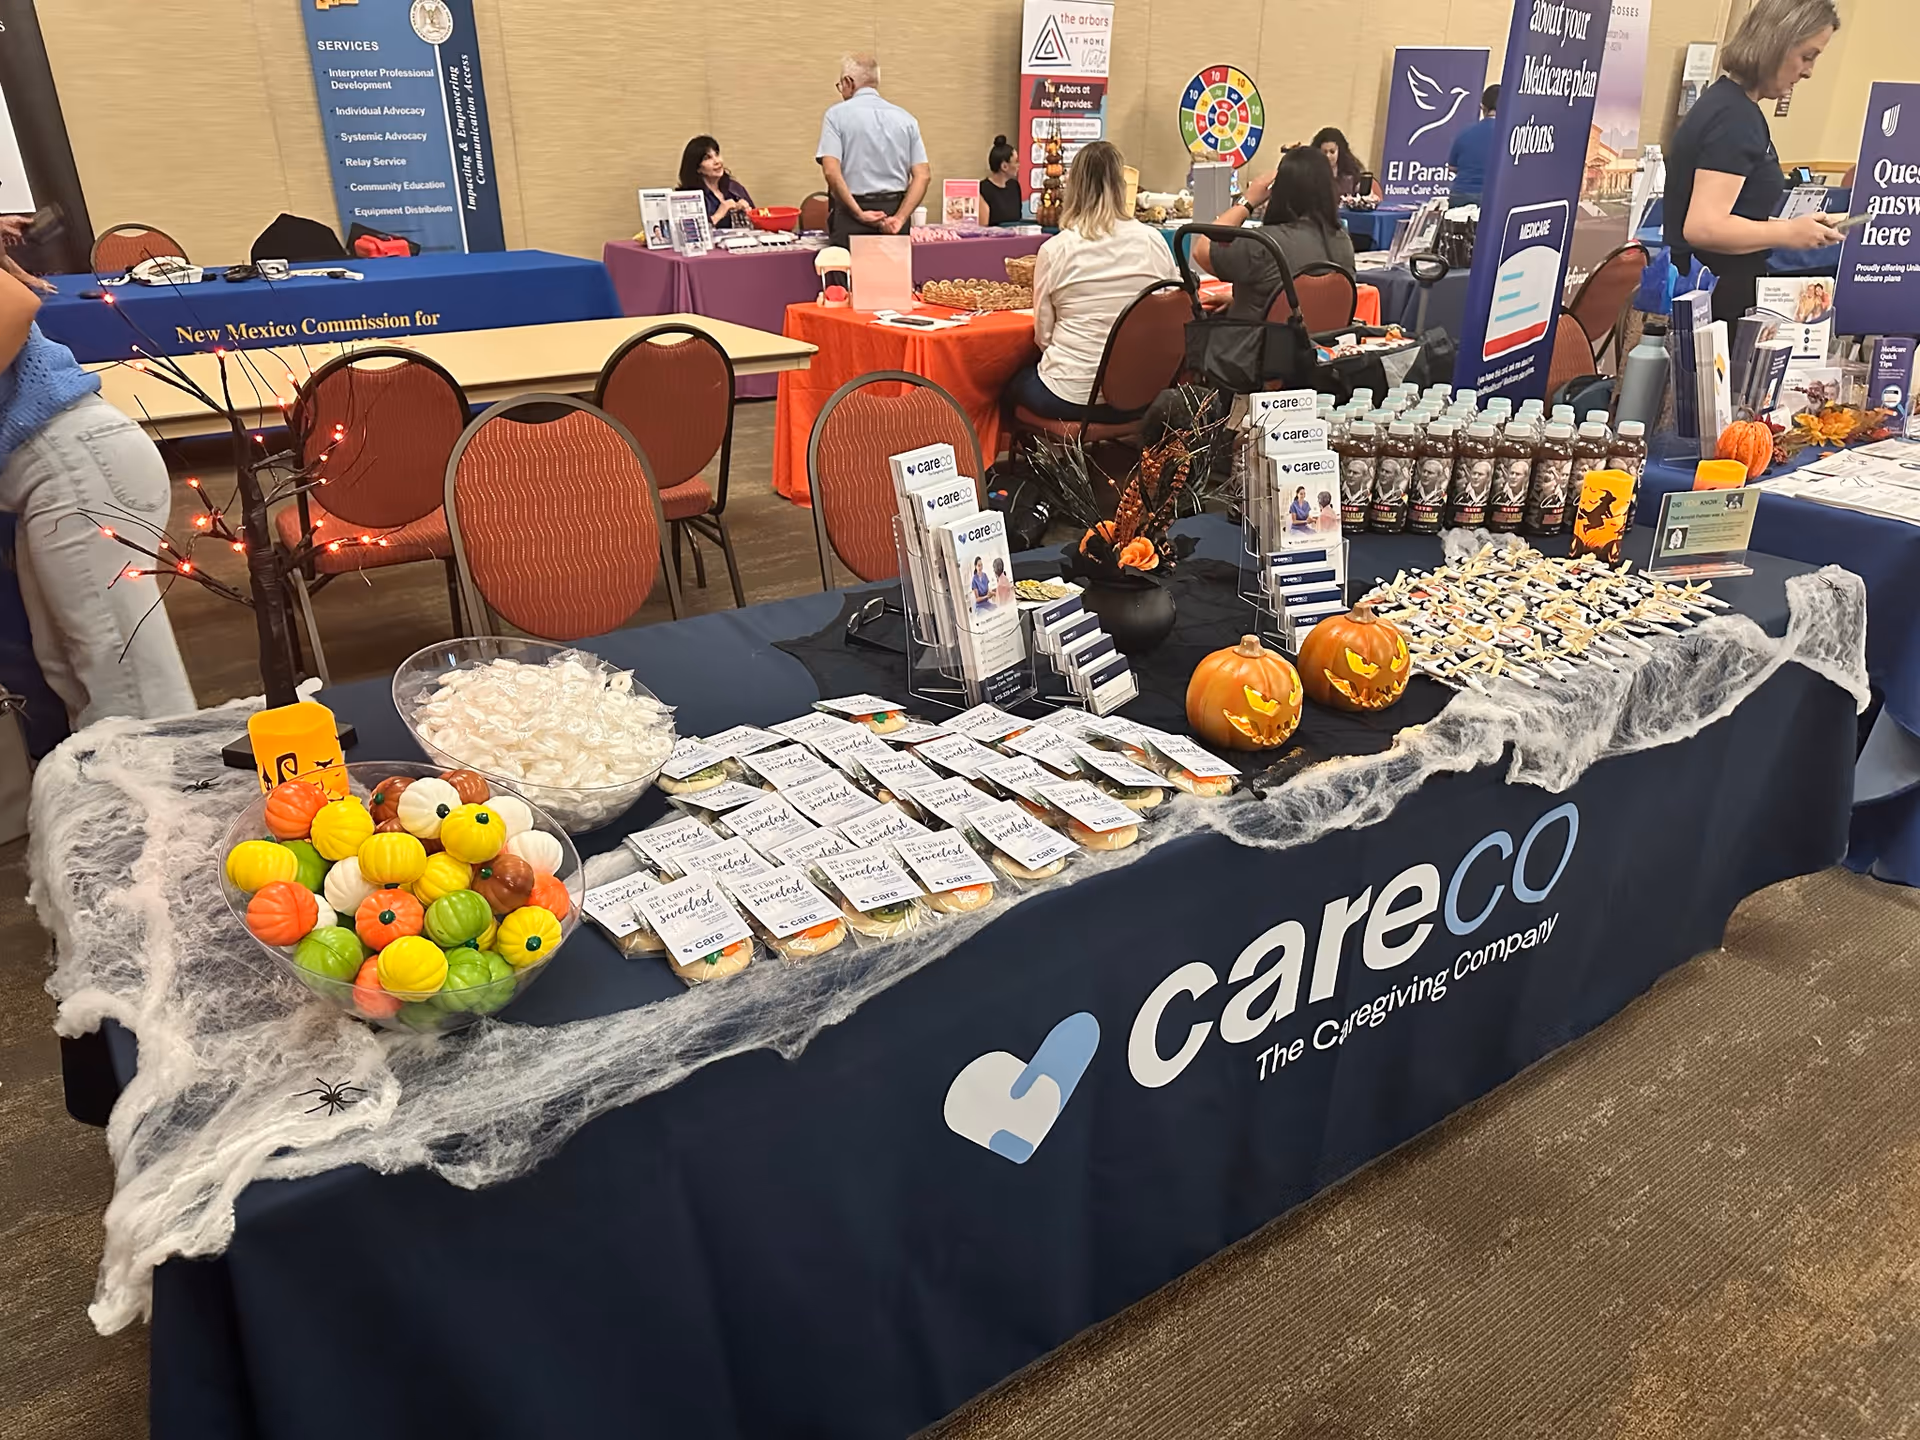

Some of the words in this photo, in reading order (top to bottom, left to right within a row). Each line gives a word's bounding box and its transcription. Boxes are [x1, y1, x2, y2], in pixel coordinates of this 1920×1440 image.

[1060, 13, 1076, 25] the
[1078, 14, 1109, 27] arbors
[1530, 0, 1565, 36] about
[1561, 8, 1592, 47] your
[317, 41, 379, 51] SERVICES
[1083, 37, 1105, 47] HOME
[329, 69, 377, 78] Interpreter
[379, 68, 434, 77] Professional
[460, 54, 474, 93] Access
[1211, 71, 1220, 81] 10
[1518, 54, 1573, 97] Medicare
[1568, 59, 1598, 107] plan
[331, 81, 392, 90] Development
[1059, 84, 1081, 94] Arbors
[1236, 78, 1246, 89] 10
[449, 66, 466, 138] Empowering
[1062, 99, 1094, 109] provides:
[1189, 89, 1199, 100] 10
[336, 107, 381, 116] Individual
[383, 106, 425, 117] Advocacy
[1251, 105, 1260, 115] 10
[340, 132, 382, 142] Systemic
[385, 131, 427, 142] Advocacy
[1185, 121, 1194, 132] 10
[459, 142, 468, 151] &
[467, 96, 486, 185] Communication
[1247, 136, 1256, 147] 10
[1510, 114, 1554, 165] options.
[345, 158, 371, 168] Relay
[373, 157, 407, 166] Service
[1388, 161, 1403, 181] El
[350, 183, 402, 192] Community
[404, 180, 445, 190] Education
[461, 155, 477, 211] Impacting
[1385, 184, 1409, 195] Home
[1411, 184, 1432, 195] Care
[355, 206, 403, 217] Equipment
[405, 204, 453, 214] Distribution
[1519, 218, 1552, 240] MEDICARE
[1860, 219, 1911, 246] here
[1853, 273, 1883, 282] Medicare
[1883, 274, 1902, 283] plans
[1856, 263, 1880, 273] Proudly
[1881, 263, 1905, 273] offering
[175, 325, 221, 344] New
[226, 320, 297, 342] Mexico
[301, 312, 411, 336] Commission
[415, 310, 440, 326] for
[1272, 397, 1313, 409] careco
[1282, 428, 1323, 440] careco
[917, 454, 953, 474] careco
[1293, 459, 1335, 472] careco
[937, 486, 972, 507] careco
[968, 520, 1002, 541] careco
[965, 712, 1000, 731] sweetest
[833, 735, 873, 755] sweetest
[941, 742, 977, 761] sweetest
[1034, 734, 1065, 754] sweetest
[766, 753, 809, 772] sweetest
[876, 759, 918, 775] sweetest
[1007, 768, 1043, 785] sweetest
[809, 786, 851, 811] sweetest
[931, 788, 972, 809] sweetest
[1064, 791, 1102, 808] sweetest
[734, 804, 778, 826] REFERRALS
[746, 808, 790, 835] sweetest
[645, 824, 694, 844] REFERRALS
[865, 818, 908, 847] sweetest
[994, 816, 1033, 841] sweetest
[656, 828, 704, 853] sweetest
[906, 838, 954, 853] REFERRALS
[690, 848, 739, 869] REFERRALS
[829, 854, 878, 871] REFERRALS
[915, 844, 964, 864] sweetest
[839, 860, 890, 882] sweetest
[742, 874, 792, 895] REFERRALS
[753, 879, 805, 907] sweetest
[598, 882, 650, 912] sweetest
[649, 883, 703, 910] REFERRALS
[659, 888, 714, 925] sweetest
[1127, 801, 1580, 1089] careco
[1256, 1034, 1305, 1081] The
[1312, 968, 1450, 1052] Caregiving
[1453, 912, 1559, 982] Company
